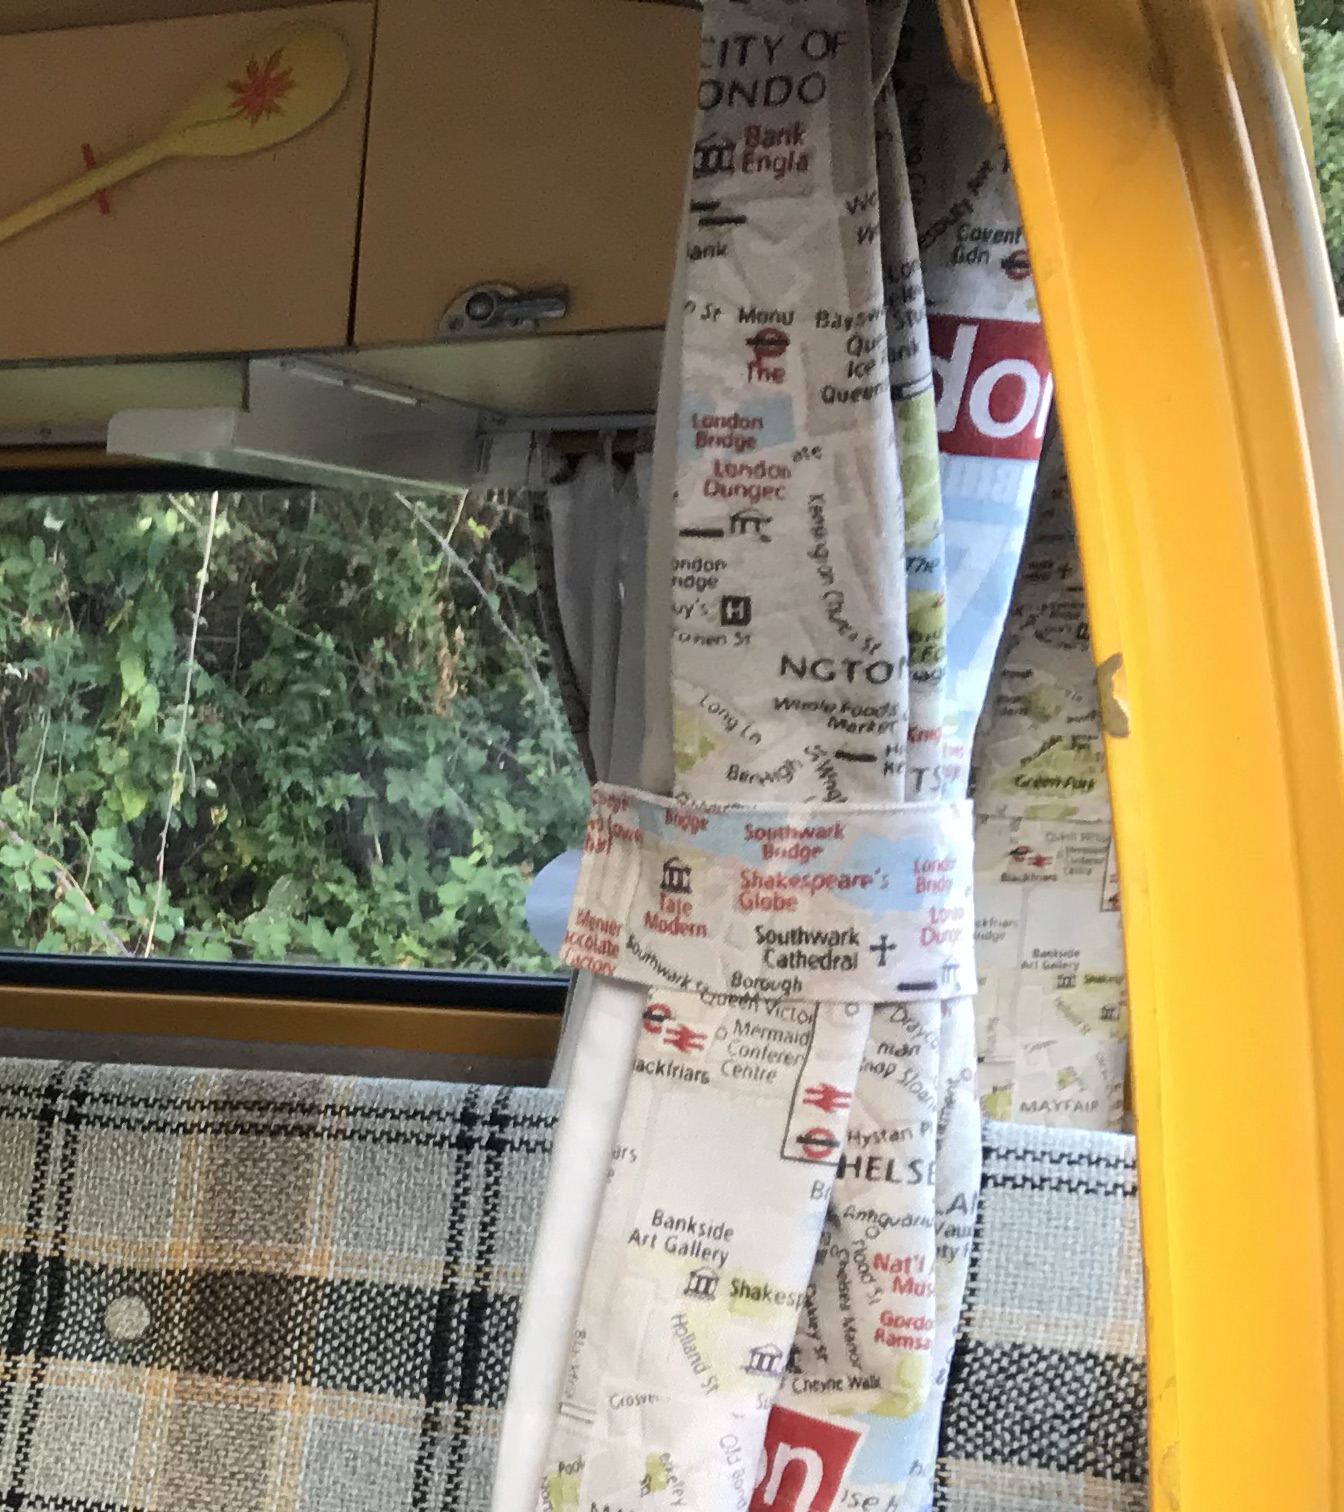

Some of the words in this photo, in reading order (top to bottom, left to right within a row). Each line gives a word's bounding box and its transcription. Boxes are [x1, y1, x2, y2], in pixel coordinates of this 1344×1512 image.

[744, 121, 807, 149] Bank
[931, 323, 1054, 440] do
[692, 412, 765, 431] London
[695, 431, 758, 454] Bridge
[714, 459, 792, 480] London
[744, 821, 846, 842] Southwark
[762, 843, 824, 865] Bridge
[738, 892, 799, 914] Globe
[643, 911, 708, 938] Modern
[755, 924, 861, 948] Southwark
[625, 932, 693, 991] Southwark
[761, 949, 859, 972] Cathedral
[729, 970, 803, 996] Borough
[732, 1018, 811, 1047] Mermaid
[720, 1059, 778, 1085] Centre
[651, 1207, 735, 1242] Bankside
[627, 1227, 658, 1250] Art
[664, 1234, 730, 1269] Gallery
[671, 1312, 709, 1376] Holland
